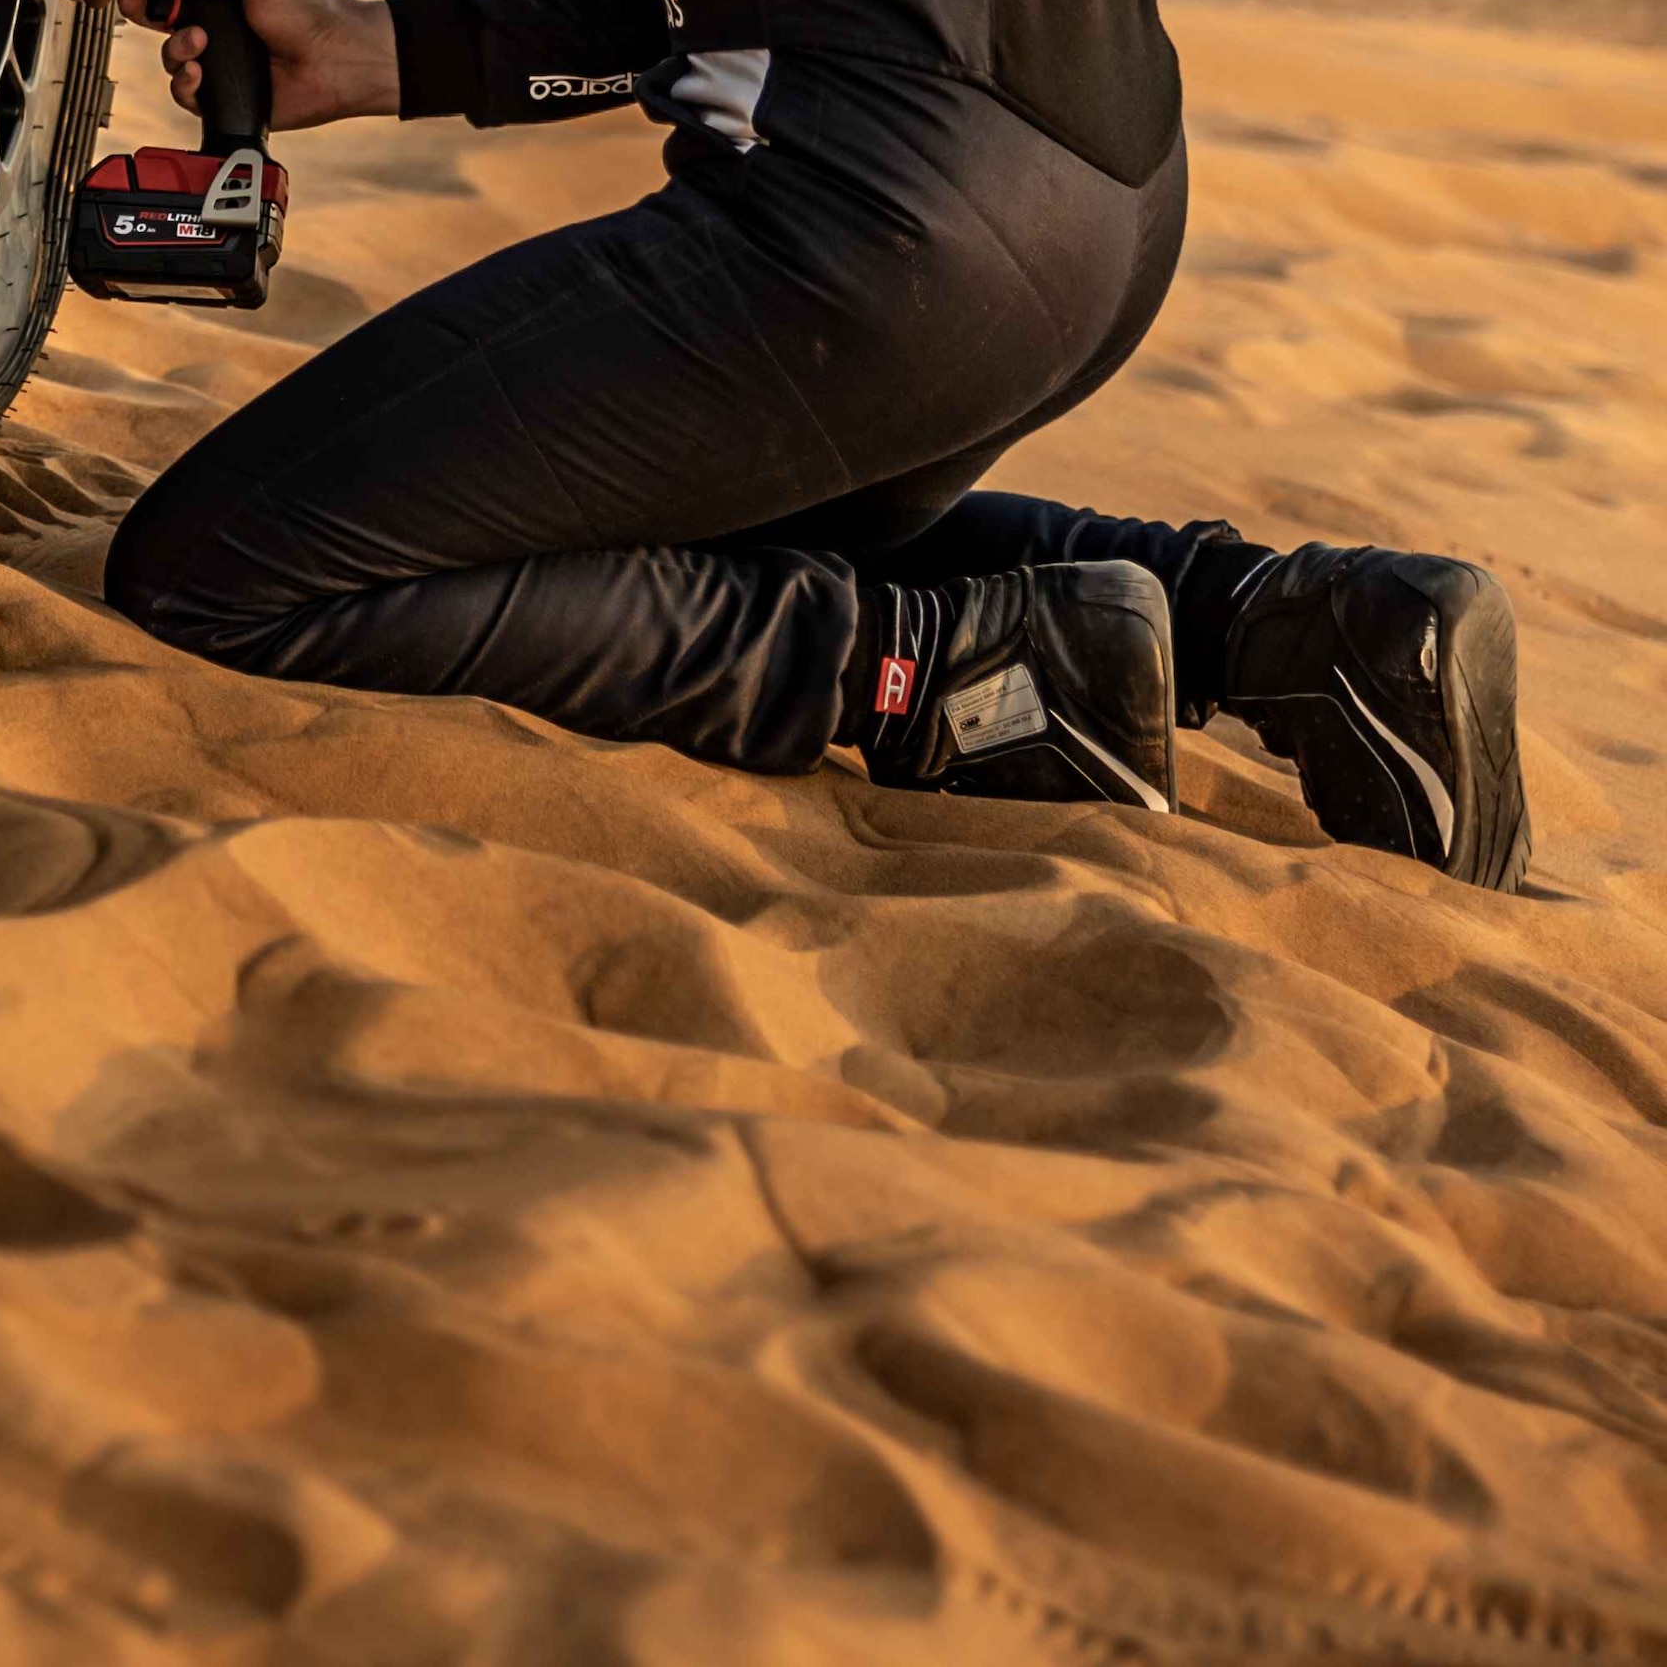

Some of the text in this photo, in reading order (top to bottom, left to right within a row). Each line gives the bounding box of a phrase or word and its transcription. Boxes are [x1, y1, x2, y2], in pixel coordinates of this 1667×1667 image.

[529, 72, 634, 101] parco
[113, 215, 147, 235] 5.0
[139, 211, 202, 223] REDLITHI
[177, 223, 215, 238] M18
